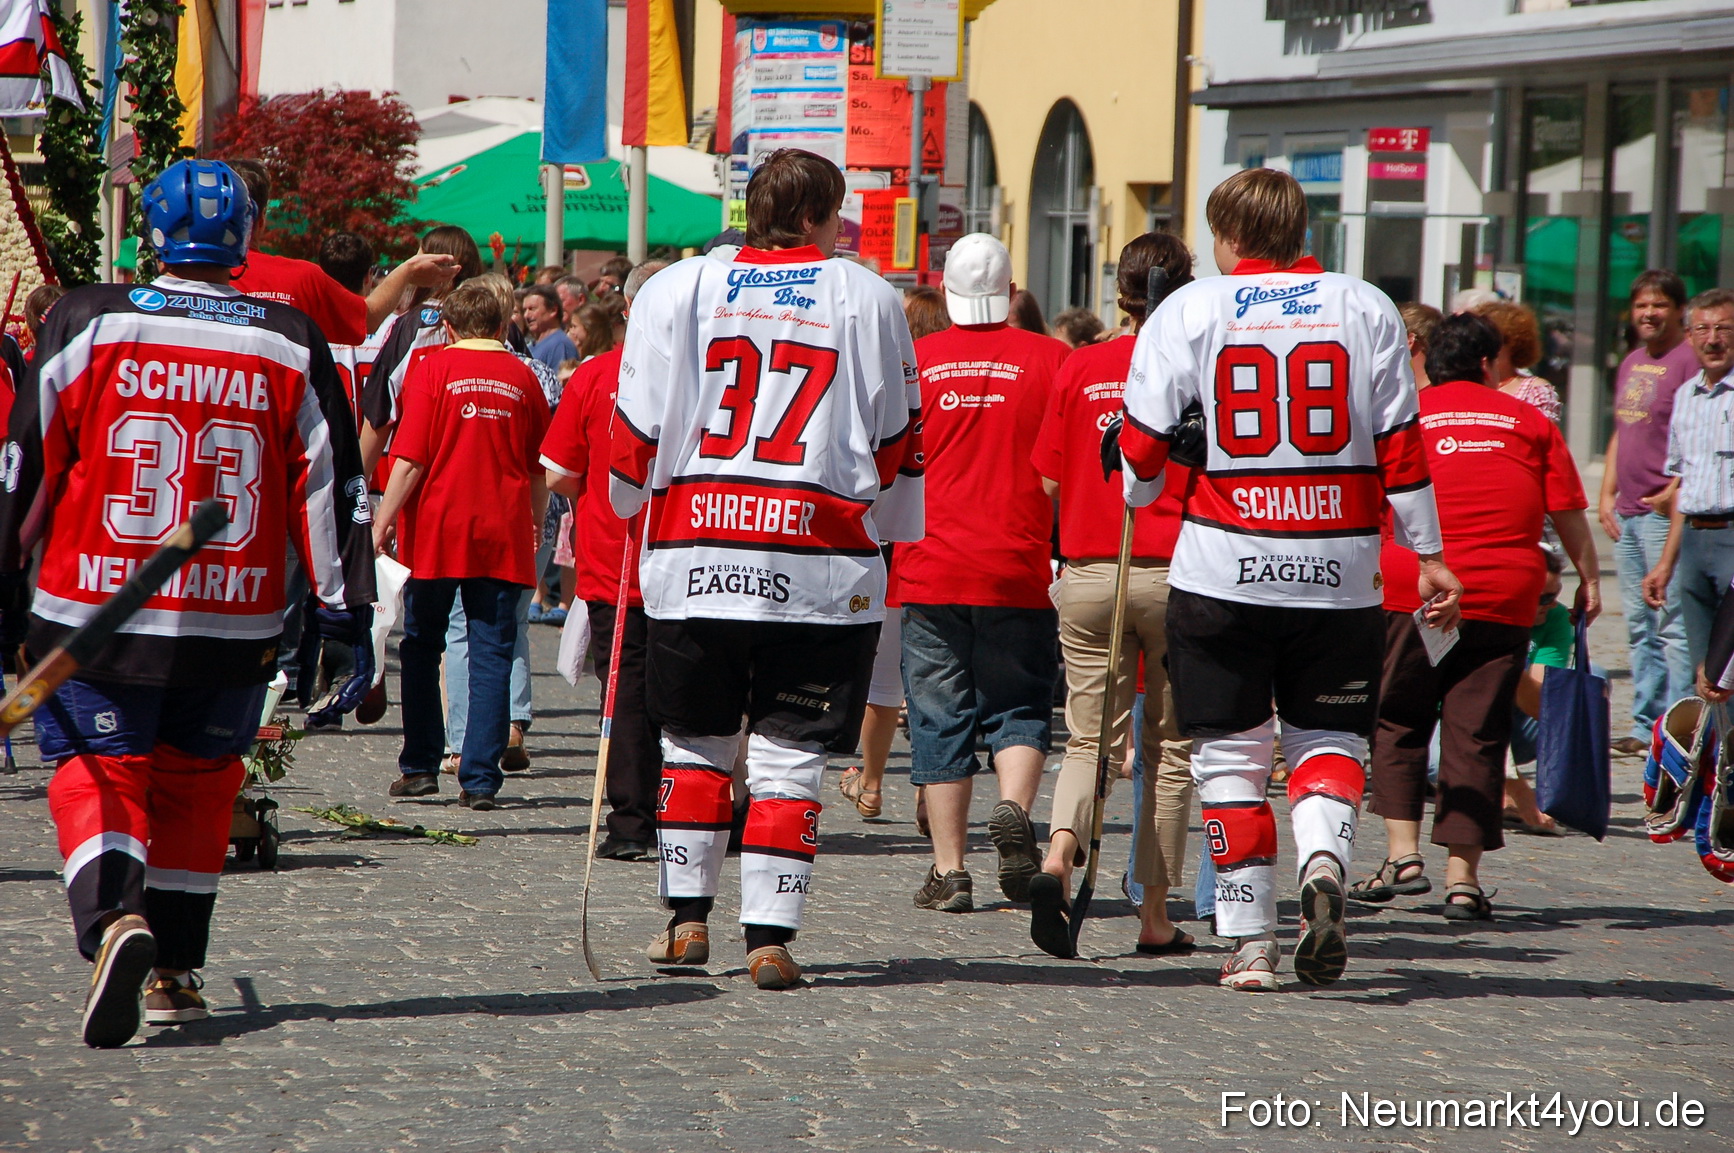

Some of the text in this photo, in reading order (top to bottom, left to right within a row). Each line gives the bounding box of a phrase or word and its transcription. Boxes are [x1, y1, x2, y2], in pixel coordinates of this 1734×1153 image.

[852, 71, 872, 81] Sa.
[851, 99, 872, 108] So.
[851, 126, 874, 135] Mo.
[727, 267, 823, 303] Glossner
[276, 292, 291, 300] FELIX
[773, 286, 816, 310] Bier
[1235, 280, 1321, 319] Glossner
[167, 294, 266, 319] ZURICH
[713, 306, 734, 319] Der
[1281, 299, 1322, 315] Bier
[187, 310, 249, 326] John GmbH
[1226, 320, 1243, 331] Der
[1245, 320, 1285, 333] hochfeine
[116, 358, 270, 411] SCHWAB
[700, 334, 839, 466] 37
[960, 393, 1005, 402] Lebenshilfe
[1214, 341, 1351, 459] 88
[1458, 440, 1505, 448] Lebenshilfe
[102, 411, 265, 551] 33
[1232, 485, 1343, 521] SCHAUER
[1260, 554, 1324, 564] NEUMARKT
[708, 564, 772, 578] NEUMARKT
[1236, 556, 1342, 588] EAGLES
[686, 566, 791, 604] EAGLES
[1315, 694, 1369, 704] BAUER
